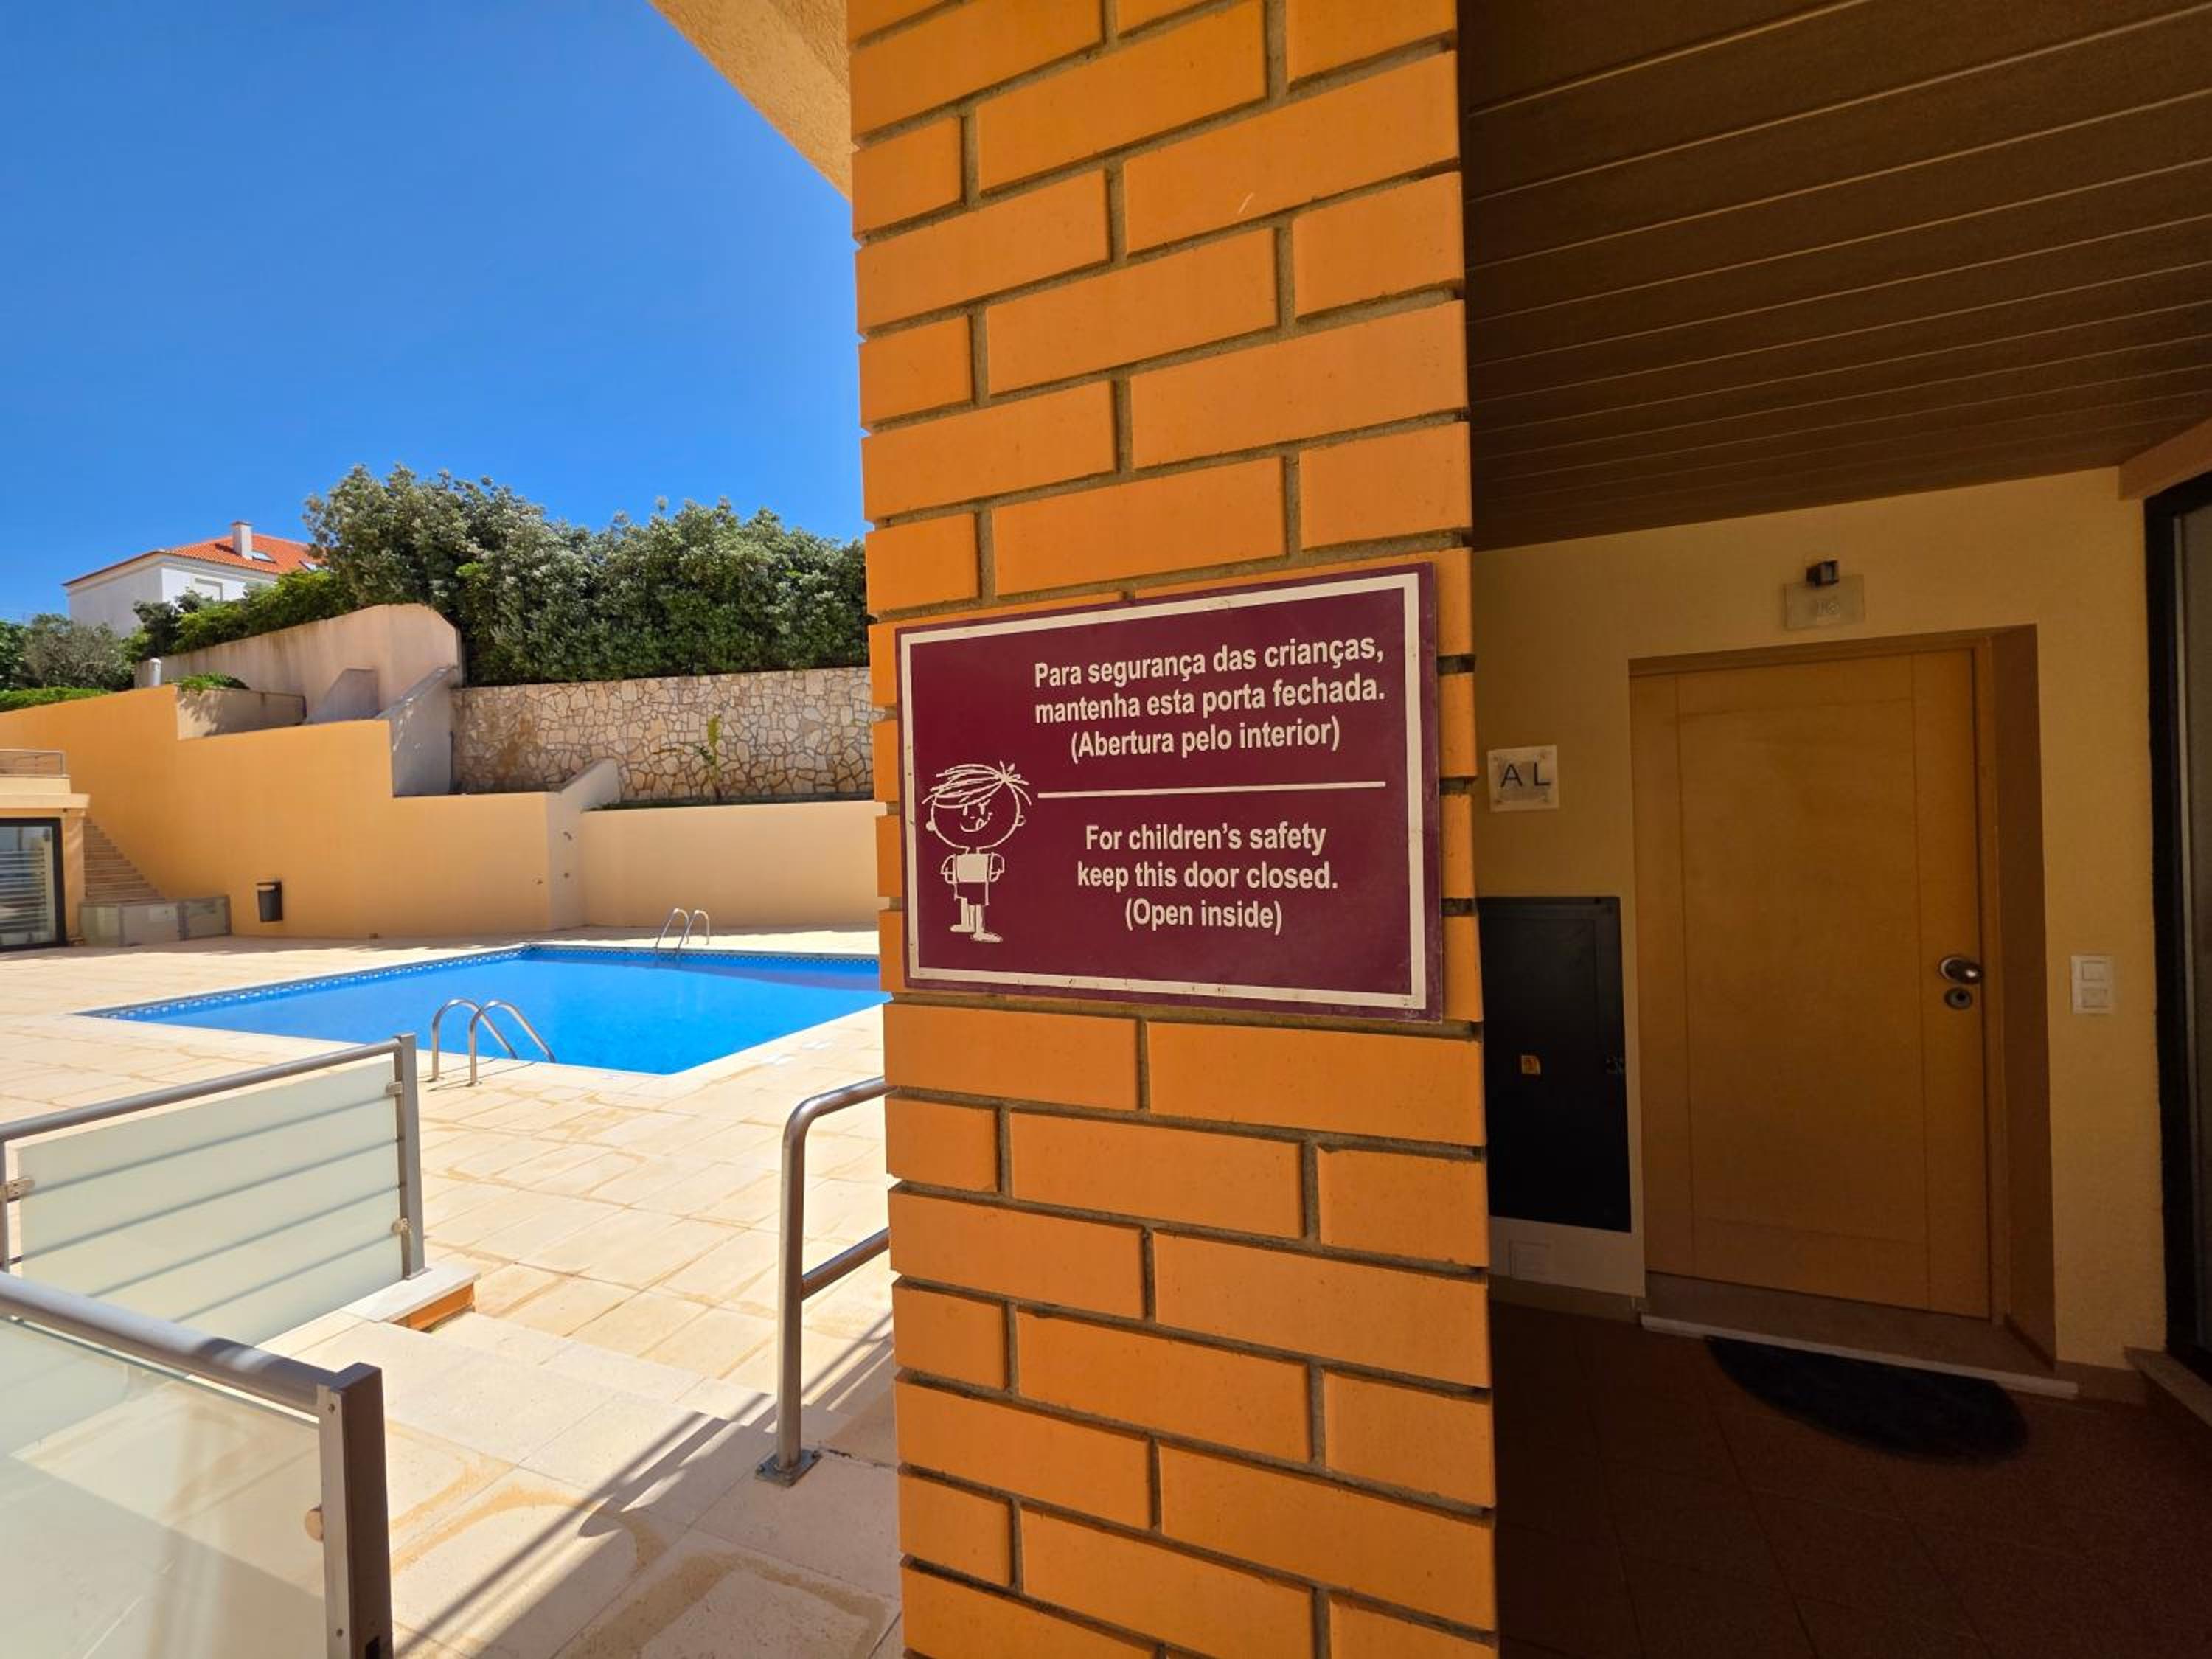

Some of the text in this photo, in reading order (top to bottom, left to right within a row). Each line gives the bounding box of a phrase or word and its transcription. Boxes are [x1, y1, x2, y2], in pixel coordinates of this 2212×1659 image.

[1035, 636, 1383, 687] Para segurança das crianças,
[1035, 672, 1384, 723] mantenha esta porta fechada.
[1071, 716, 1339, 764] (Abertura pelo interior)
[1086, 821, 1326, 855] For children’s safety
[1078, 861, 1338, 892] keep this door closed.
[1126, 898, 1281, 935] (Open inside)
